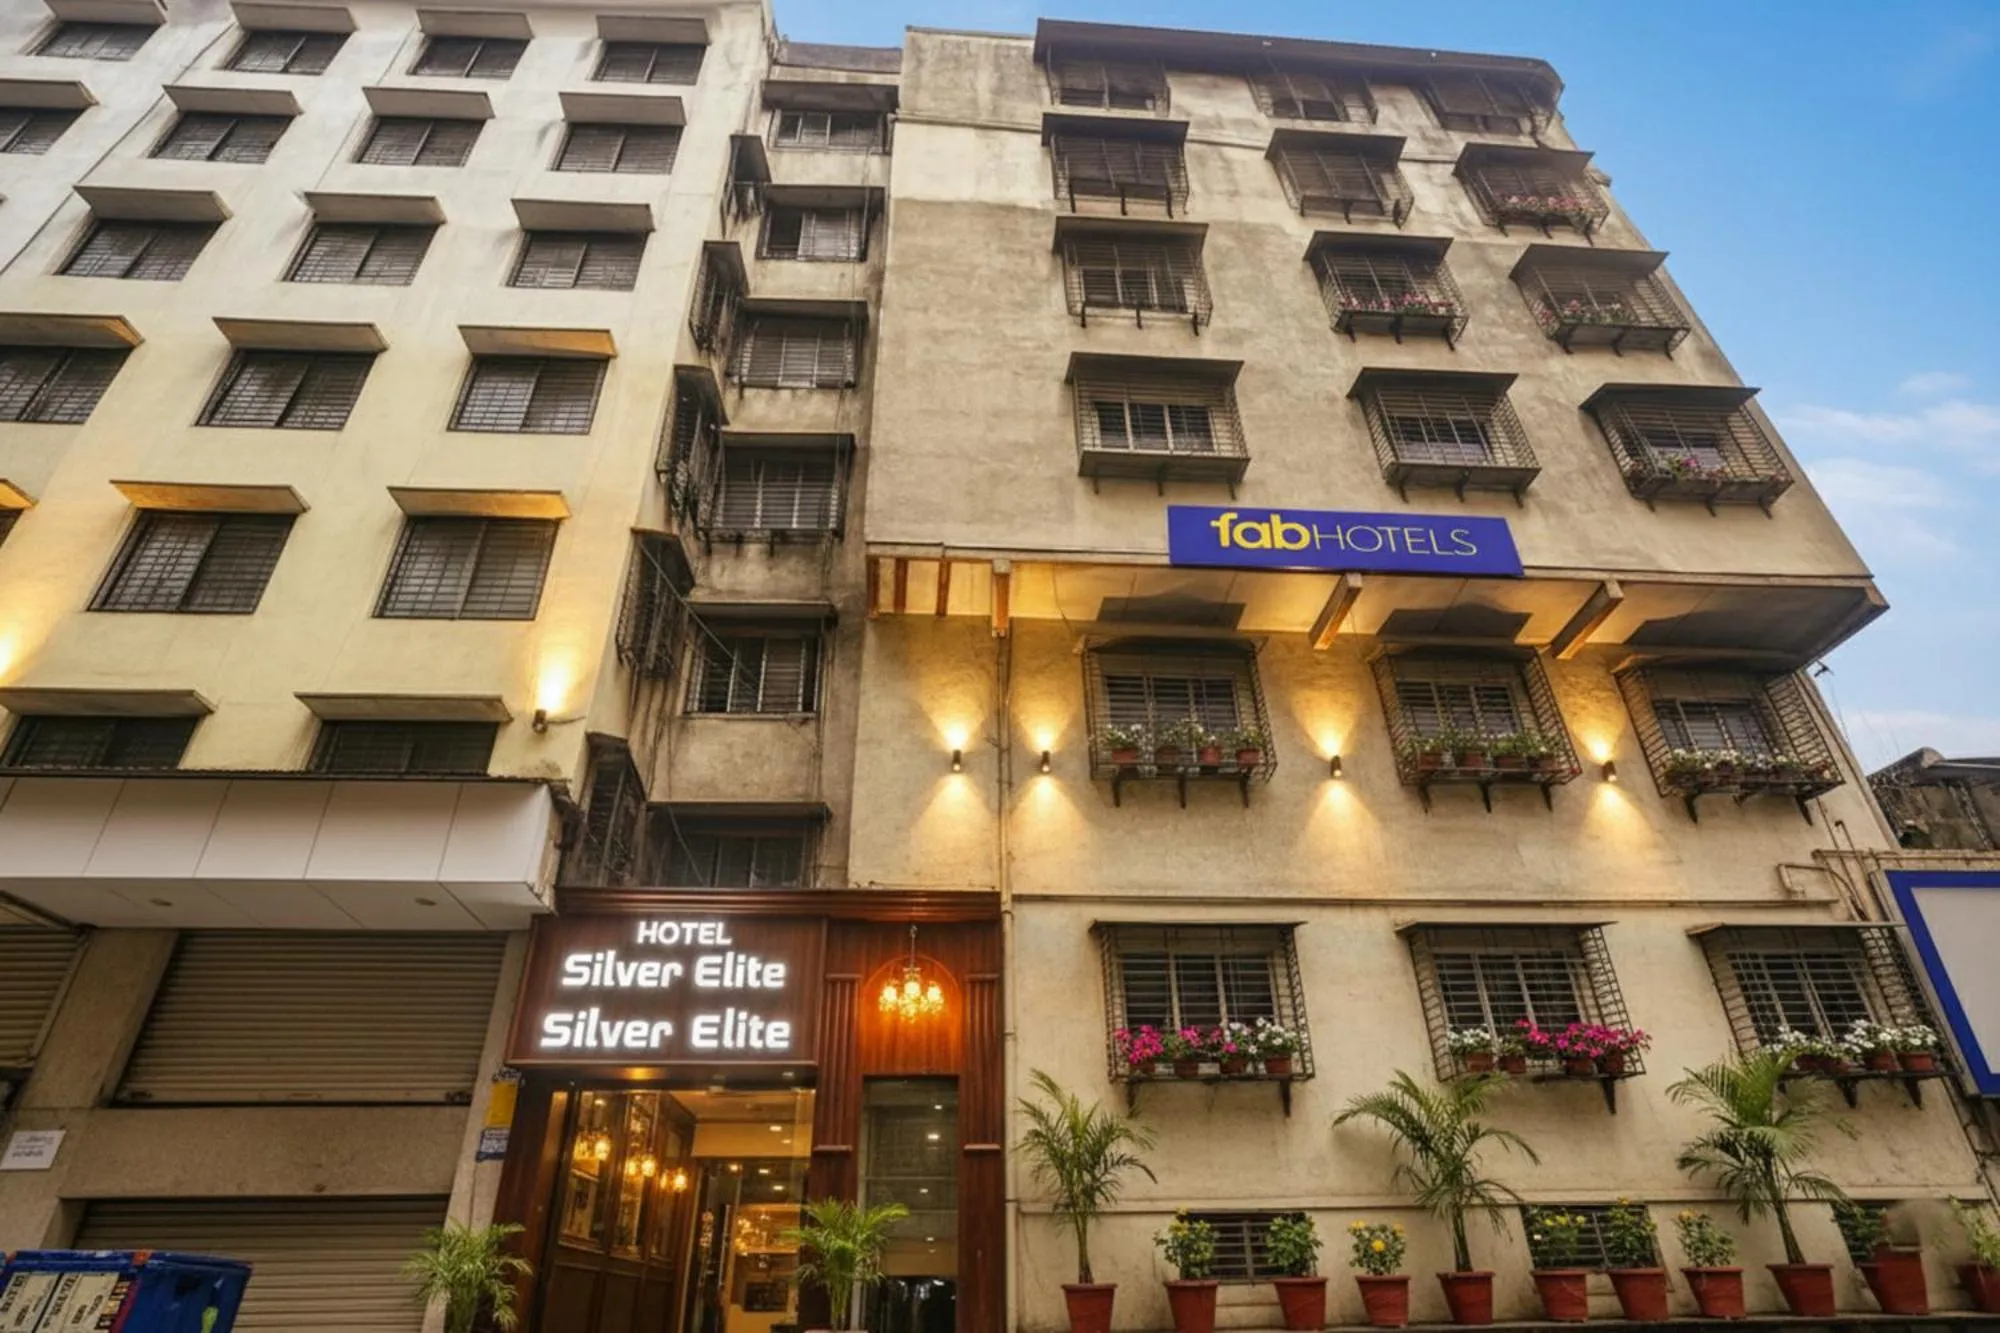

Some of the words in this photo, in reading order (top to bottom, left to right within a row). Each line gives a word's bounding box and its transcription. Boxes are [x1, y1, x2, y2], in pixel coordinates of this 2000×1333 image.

[637, 921, 732, 946] HOTEL
[562, 950, 683, 988] Silver
[694, 951, 786, 988] Elite
[540, 1007, 673, 1049] Silver
[691, 1008, 790, 1049] Elite
